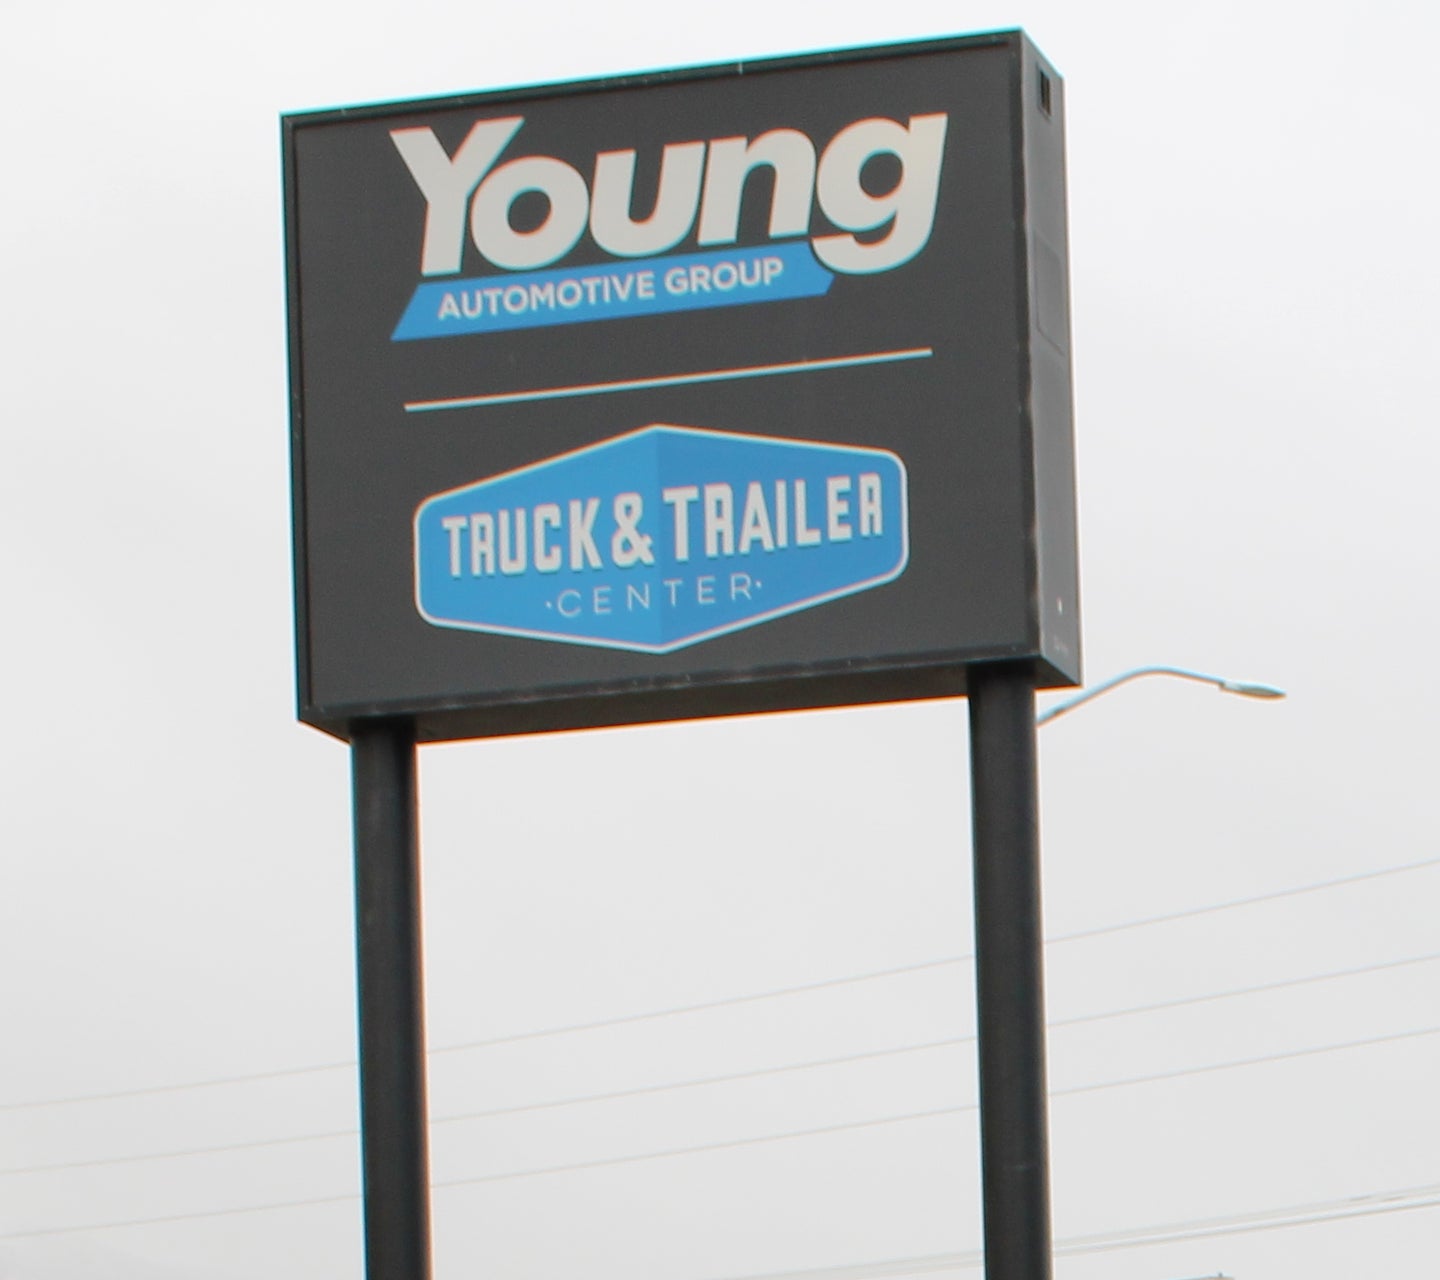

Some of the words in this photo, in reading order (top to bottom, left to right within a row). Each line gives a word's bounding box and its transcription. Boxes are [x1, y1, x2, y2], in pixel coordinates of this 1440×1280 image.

[389, 112, 948, 276] Young
[436, 271, 656, 323] AUTOMOTIVE
[665, 256, 785, 296] GROUP
[443, 496, 605, 581] TRUCK
[613, 493, 654, 568] &
[662, 472, 884, 563] TRAILER
